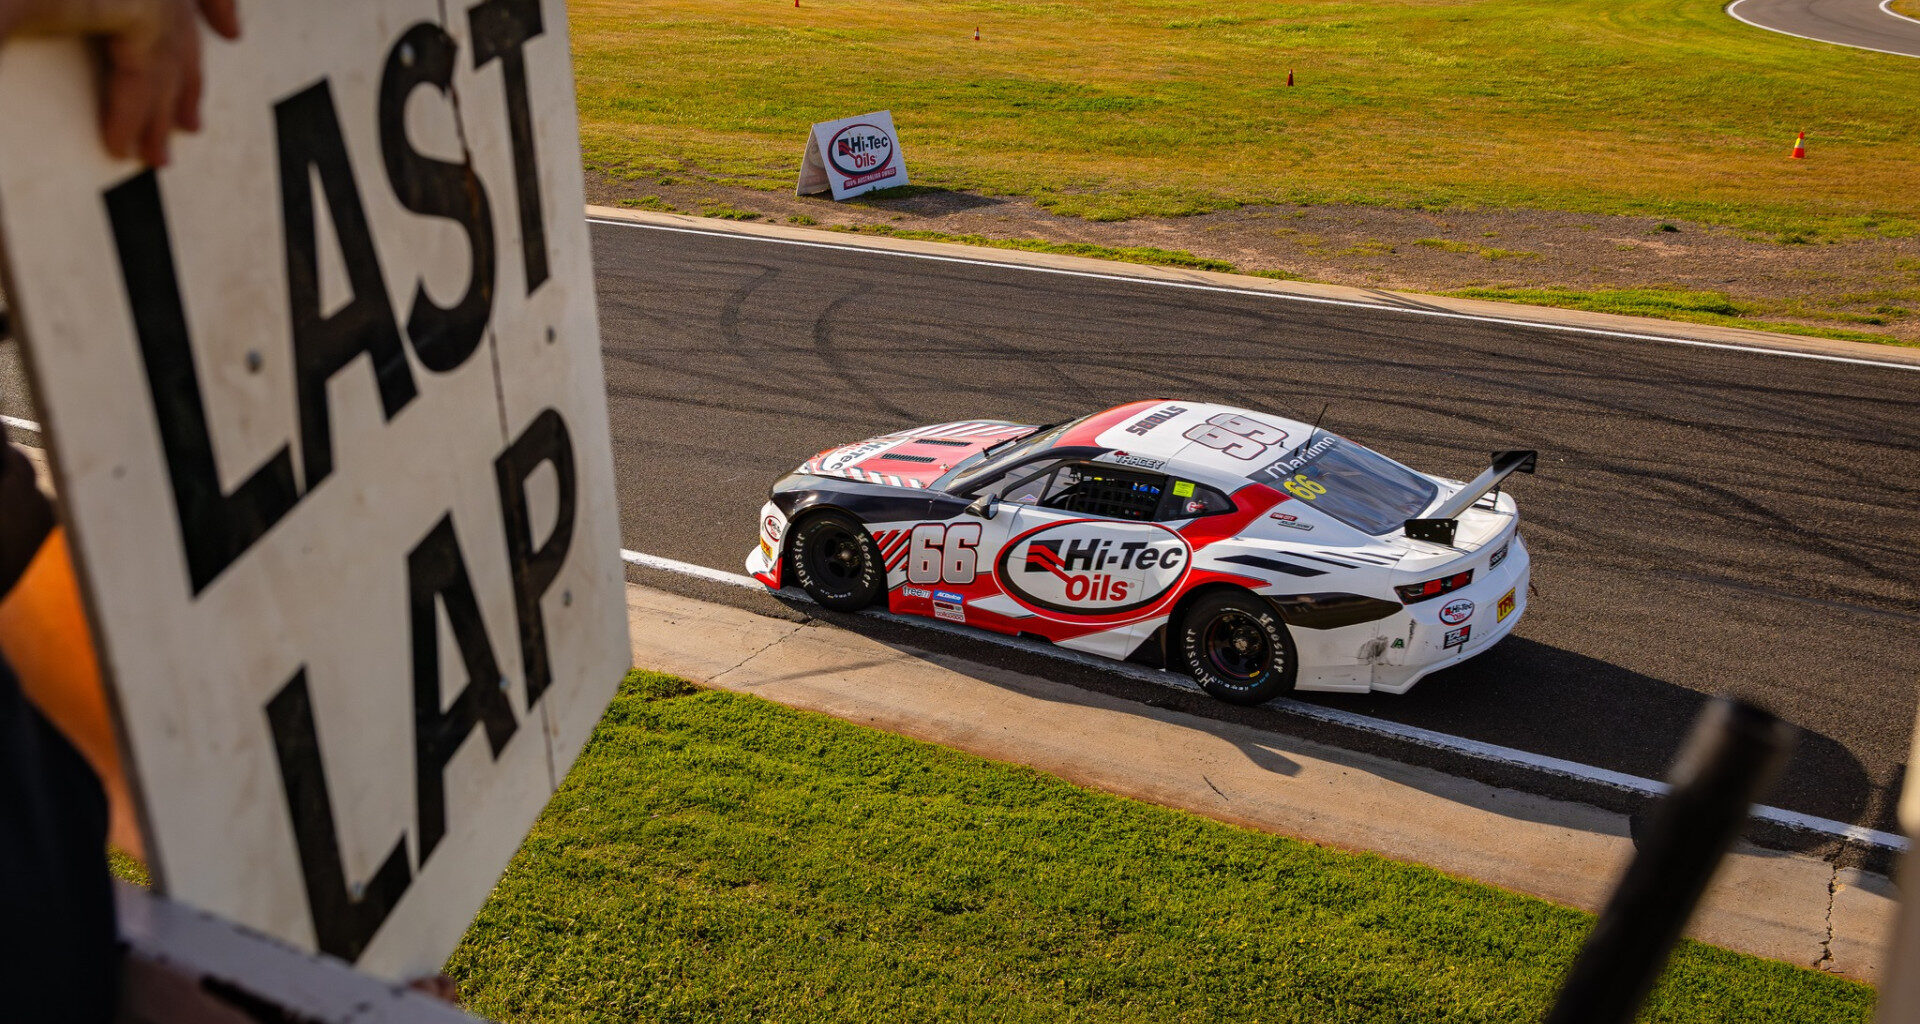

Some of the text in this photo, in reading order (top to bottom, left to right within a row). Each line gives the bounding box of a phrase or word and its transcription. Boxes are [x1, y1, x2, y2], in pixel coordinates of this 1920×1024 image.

[851, 135, 889, 153] Hi-Tec
[854, 153, 877, 168] Oils
[104, 0, 550, 597] LAST
[831, 442, 889, 470] Hi-Tec
[1116, 455, 1165, 470] TRACEY
[1283, 474, 1327, 500] 66
[794, 533, 815, 588] Hoosier
[854, 532, 875, 588] Hoosier
[907, 522, 982, 585] 66
[1064, 539, 1183, 571] Hi-Tec
[1065, 574, 1129, 601] Oils
[1184, 628, 1213, 687] Hoosier
[1259, 613, 1284, 674] Hoosier
[265, 407, 577, 963] LAP
